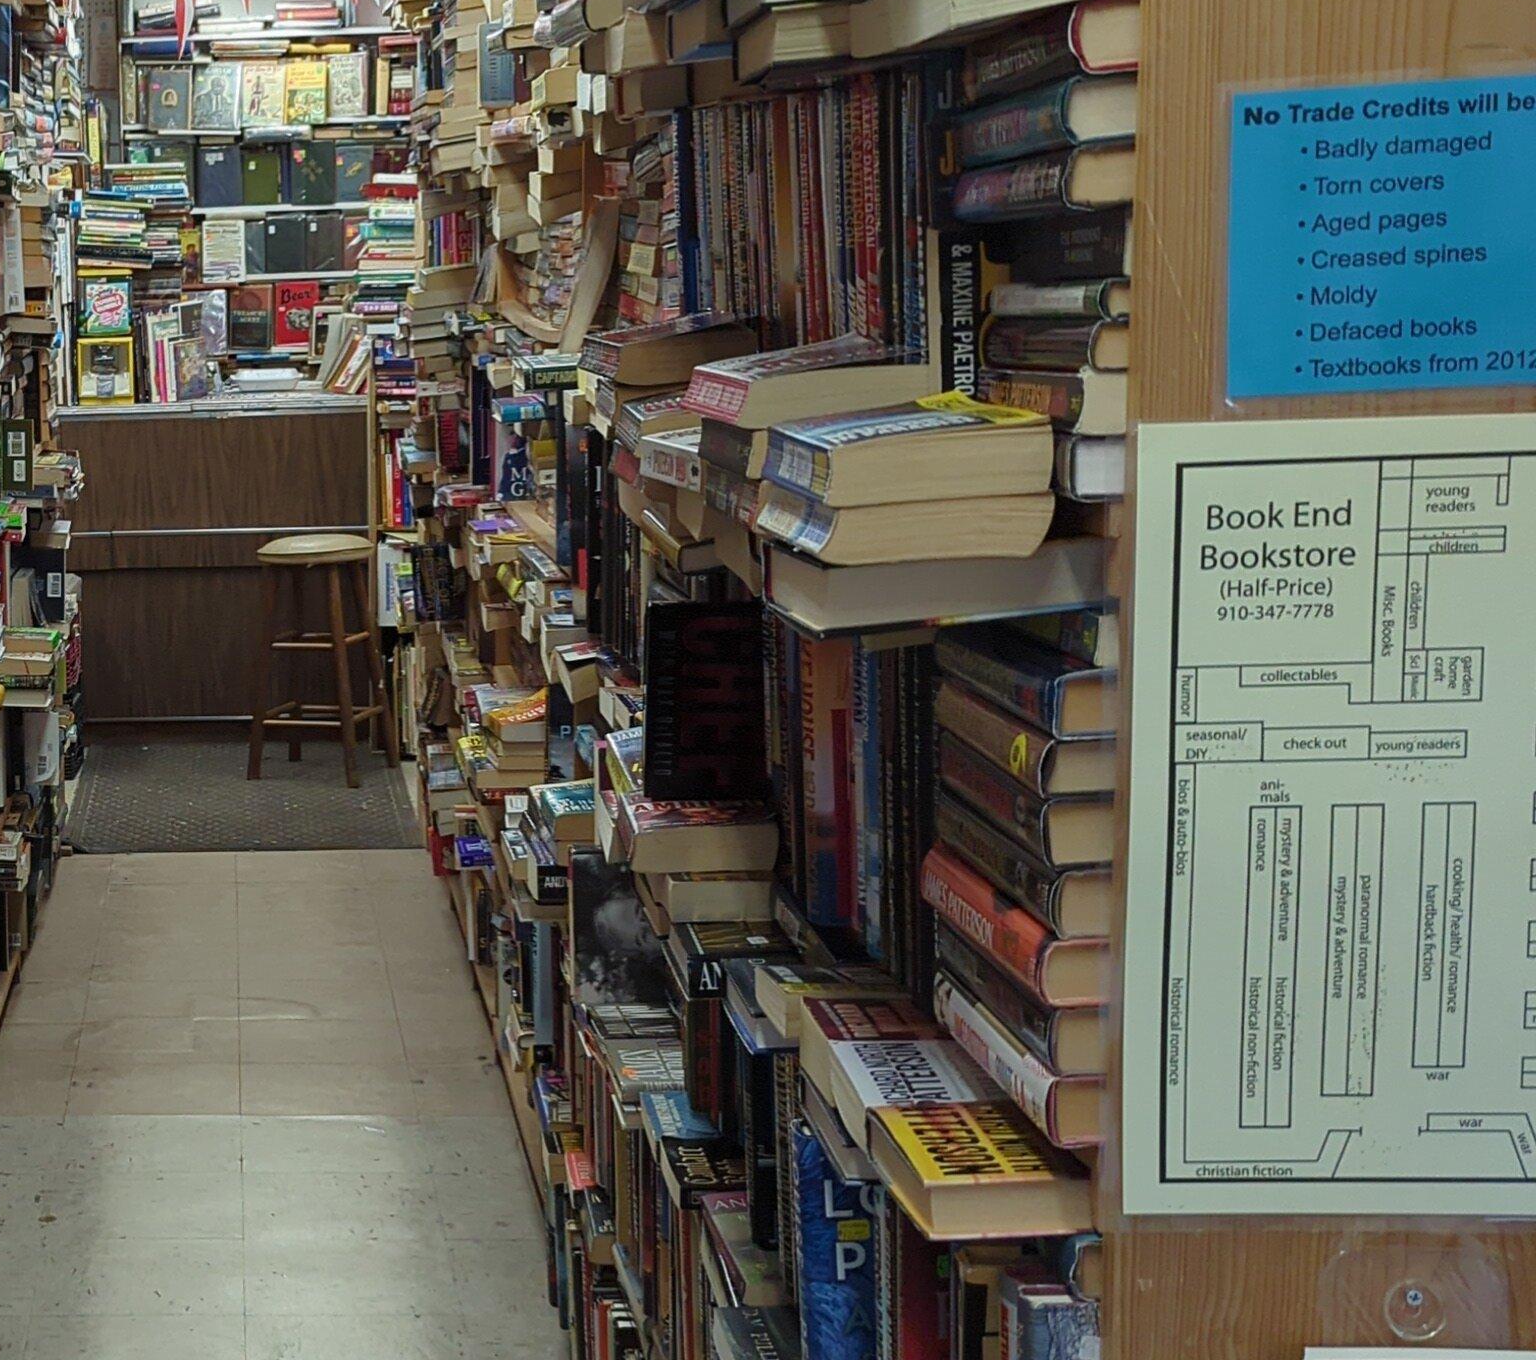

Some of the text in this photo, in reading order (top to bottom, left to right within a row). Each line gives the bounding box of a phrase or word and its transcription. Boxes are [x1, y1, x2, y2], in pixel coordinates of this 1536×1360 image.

[1244, 93, 1535, 127] No Trade Credits will be
[1315, 131, 1492, 161] Badly damaged
[1314, 174, 1444, 197] Torn covers
[1311, 210, 1448, 238] Aged pages
[1311, 244, 1487, 270] Creased spines
[281, 288, 310, 305] Bear
[1311, 286, 1377, 309] Moldy
[952, 244, 976, 396] & MAXINE PAETRO
[1310, 318, 1477, 343] Defaced books
[1309, 356, 1422, 380] Textbooks
[1429, 353, 1480, 373] from
[1426, 485, 1470, 498] young
[1206, 499, 1352, 530] Book End
[1426, 499, 1476, 513] readers
[1200, 543, 1357, 570] Bookstore
[1429, 541, 1479, 553] children
[1219, 577, 1334, 600] (Half-Price)
[1217, 603, 1334, 622] 910-347-7778
[1410, 580, 1419, 629] children
[1381, 585, 1396, 657] Misc. Books
[1260, 669, 1338, 683] collectables
[1434, 656, 1445, 682] craft
[1448, 656, 1460, 690] home
[1461, 656, 1473, 696] garden
[1181, 673, 1192, 718] humor
[1185, 728, 1248, 743] seasonal/
[1283, 737, 1347, 752] check out
[1375, 736, 1462, 753] young readers
[1186, 747, 1209, 760] DIY
[1178, 778, 1191, 805] bios
[1260, 779, 1286, 791] ani-
[1260, 790, 1291, 803] mals
[1175, 818, 1188, 876] auto-bios
[1254, 817, 1266, 872] romance
[1280, 817, 1292, 864] mystery
[925, 872, 994, 949] JAMES PATTERSON
[1278, 880, 1290, 941] adventure
[1336, 875, 1347, 922] mystery
[1356, 874, 1373, 1001] paranormal romance
[1422, 884, 1437, 982] hardback fiction
[1445, 856, 1464, 1014] cooking/ health/ romance
[1332, 936, 1344, 999] adventure
[1167, 977, 1183, 1088] historical romance
[1245, 977, 1261, 1099] historical non-fiction
[1271, 977, 1286, 1072] historical fiction
[1426, 1072, 1449, 1081] war
[1459, 1117, 1484, 1127] war
[1517, 1132, 1533, 1155] war
[1196, 1165, 1293, 1177] christian fiction
